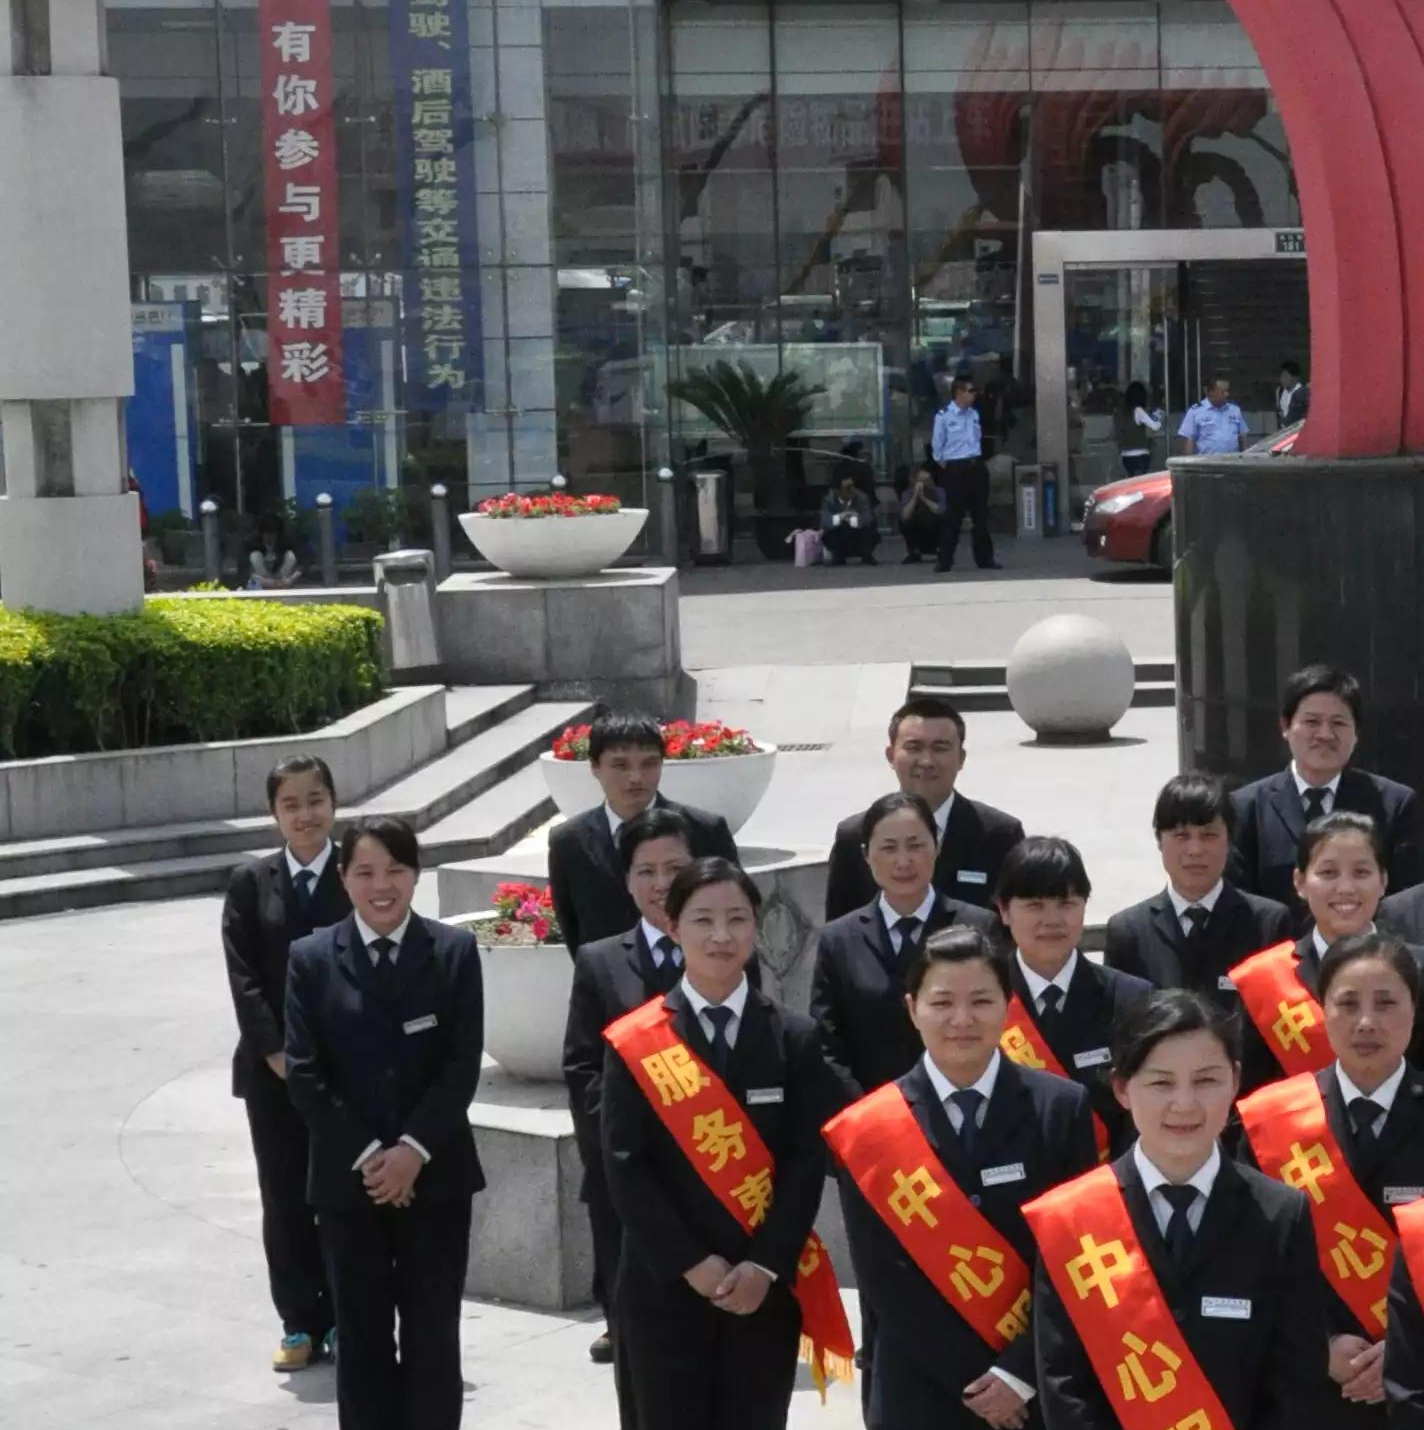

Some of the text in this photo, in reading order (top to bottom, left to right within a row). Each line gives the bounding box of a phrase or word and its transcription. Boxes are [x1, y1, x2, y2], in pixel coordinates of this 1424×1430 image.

[270, 21, 331, 384] 有你参与更精彩
[1272, 1000, 1316, 1053] 中
[1279, 1141, 1388, 1329] 中心
